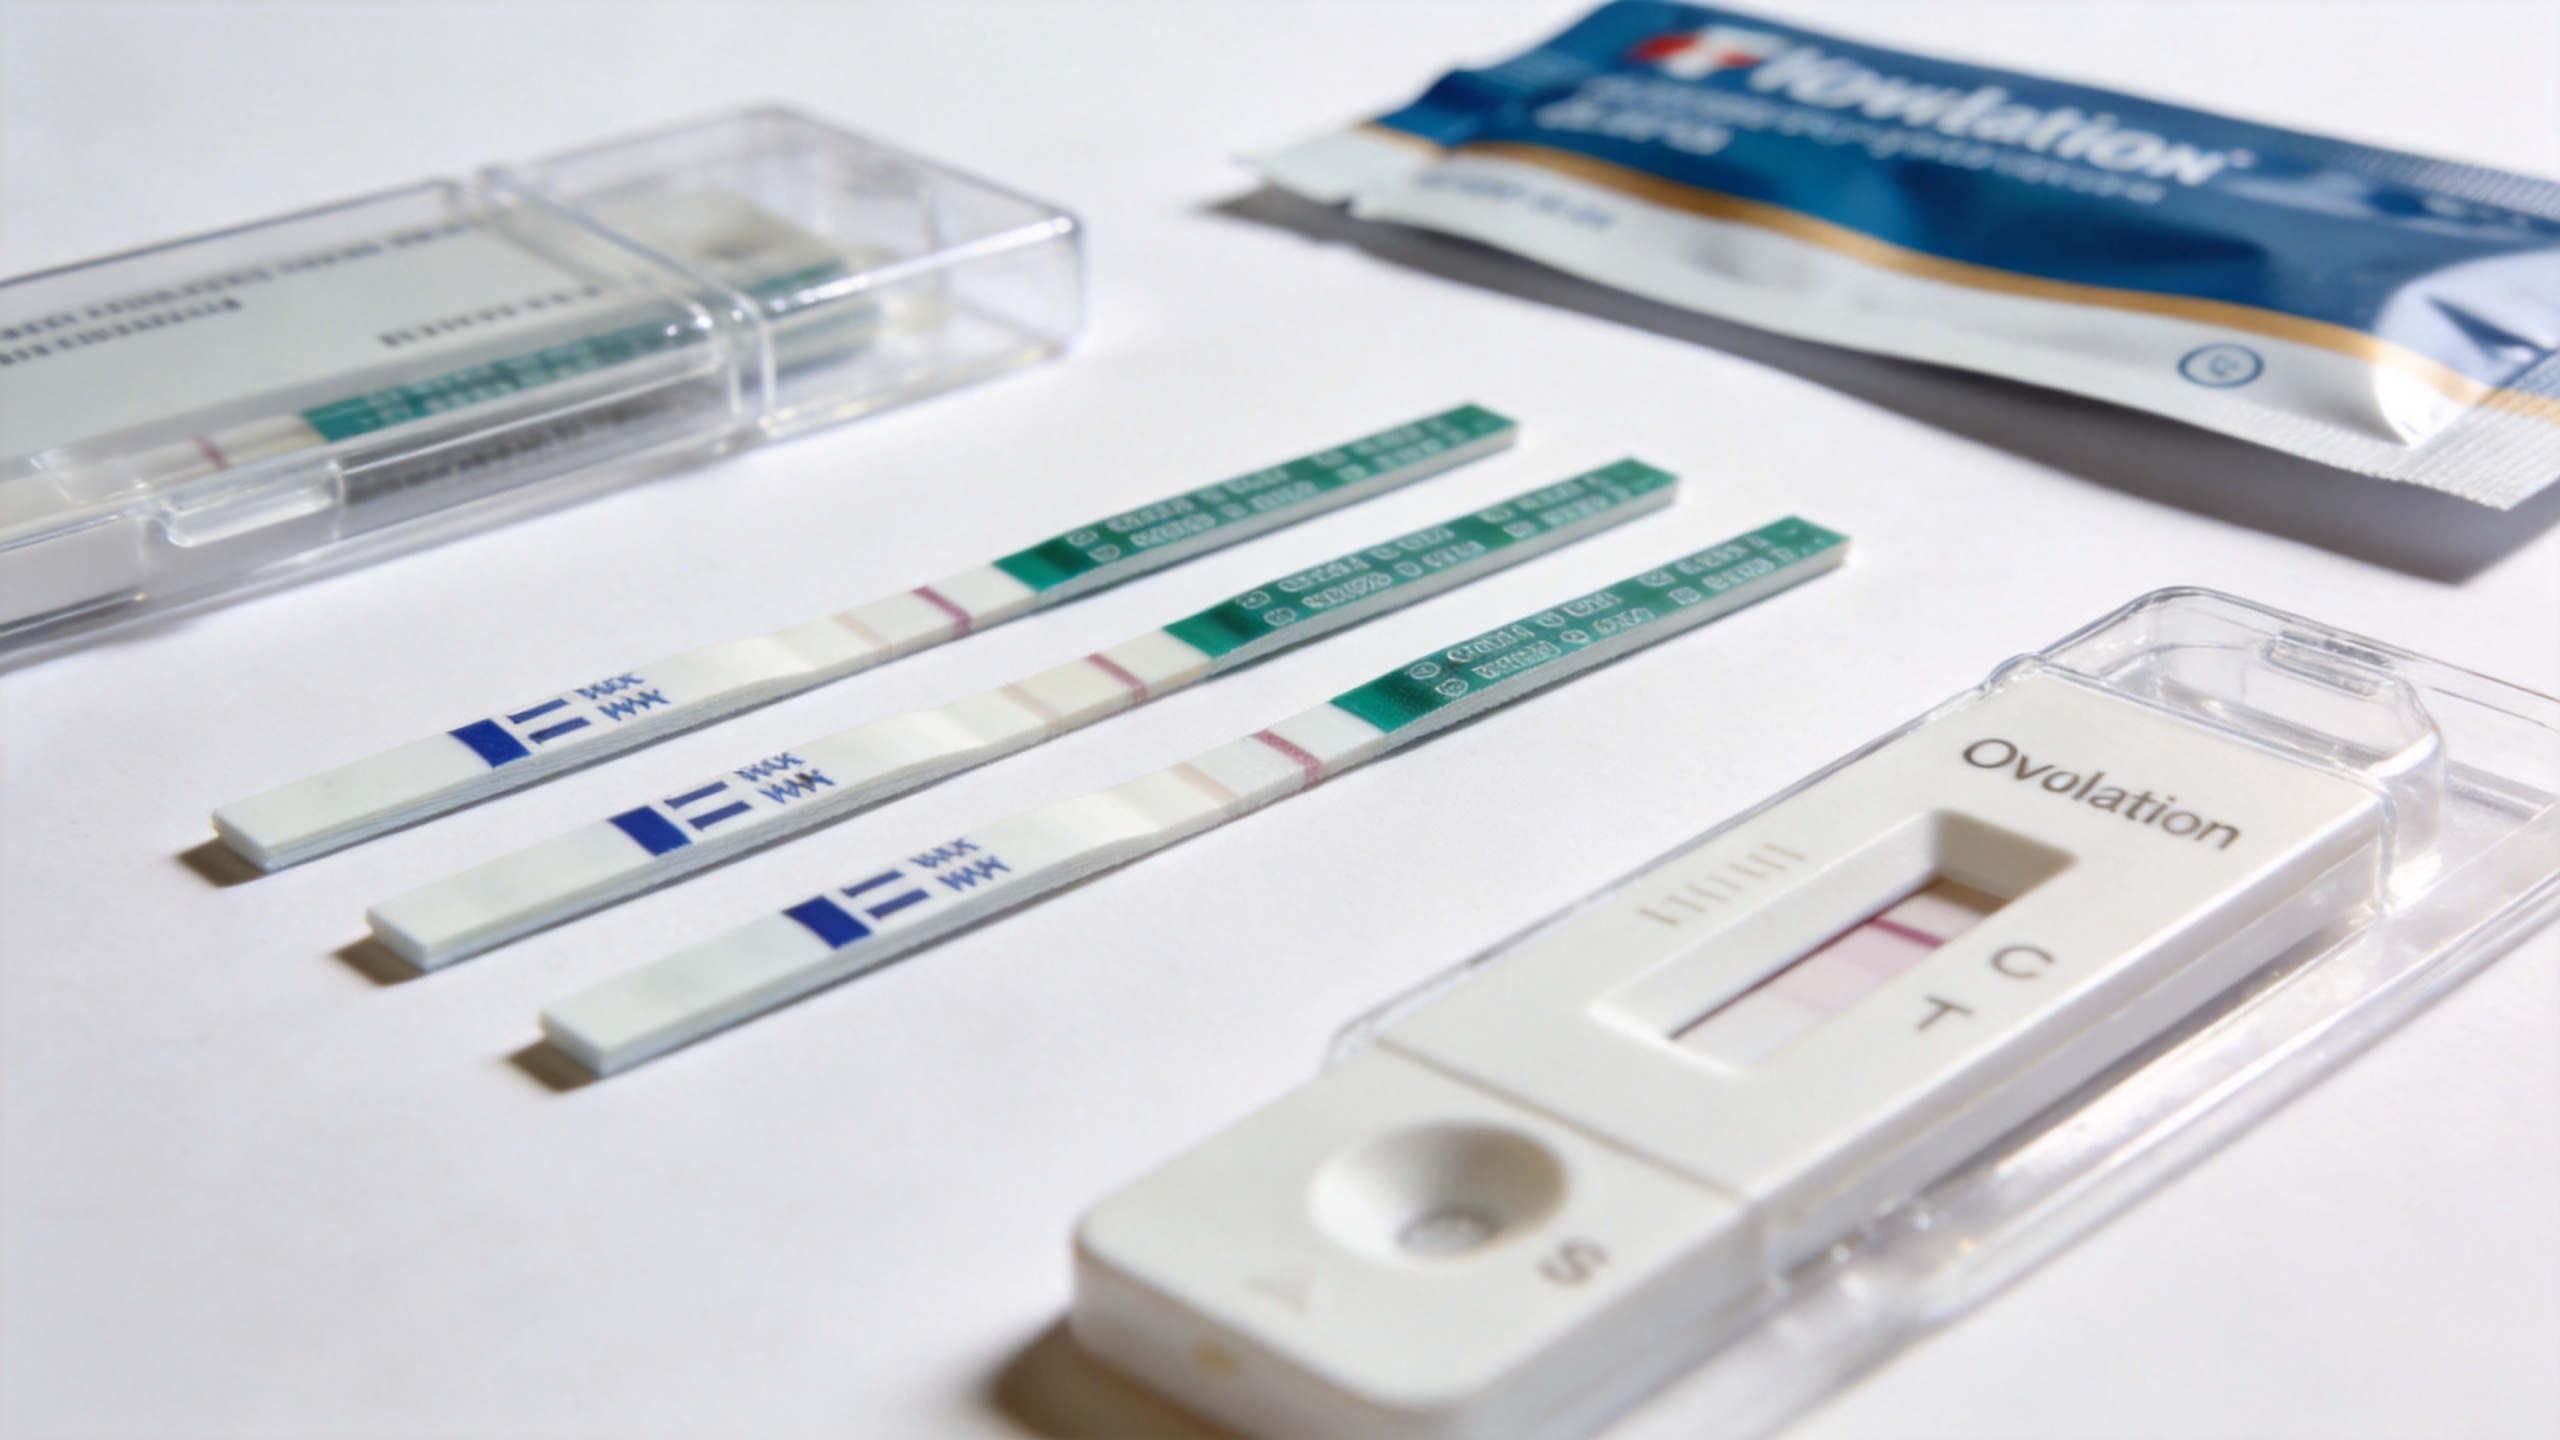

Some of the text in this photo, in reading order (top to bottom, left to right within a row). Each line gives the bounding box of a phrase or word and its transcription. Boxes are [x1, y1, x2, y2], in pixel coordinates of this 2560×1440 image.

[1961, 737, 2242, 851] Ovolation
[1991, 944, 2055, 980] C
[1916, 995, 1974, 1031] T
[1538, 1239, 1610, 1287] S
